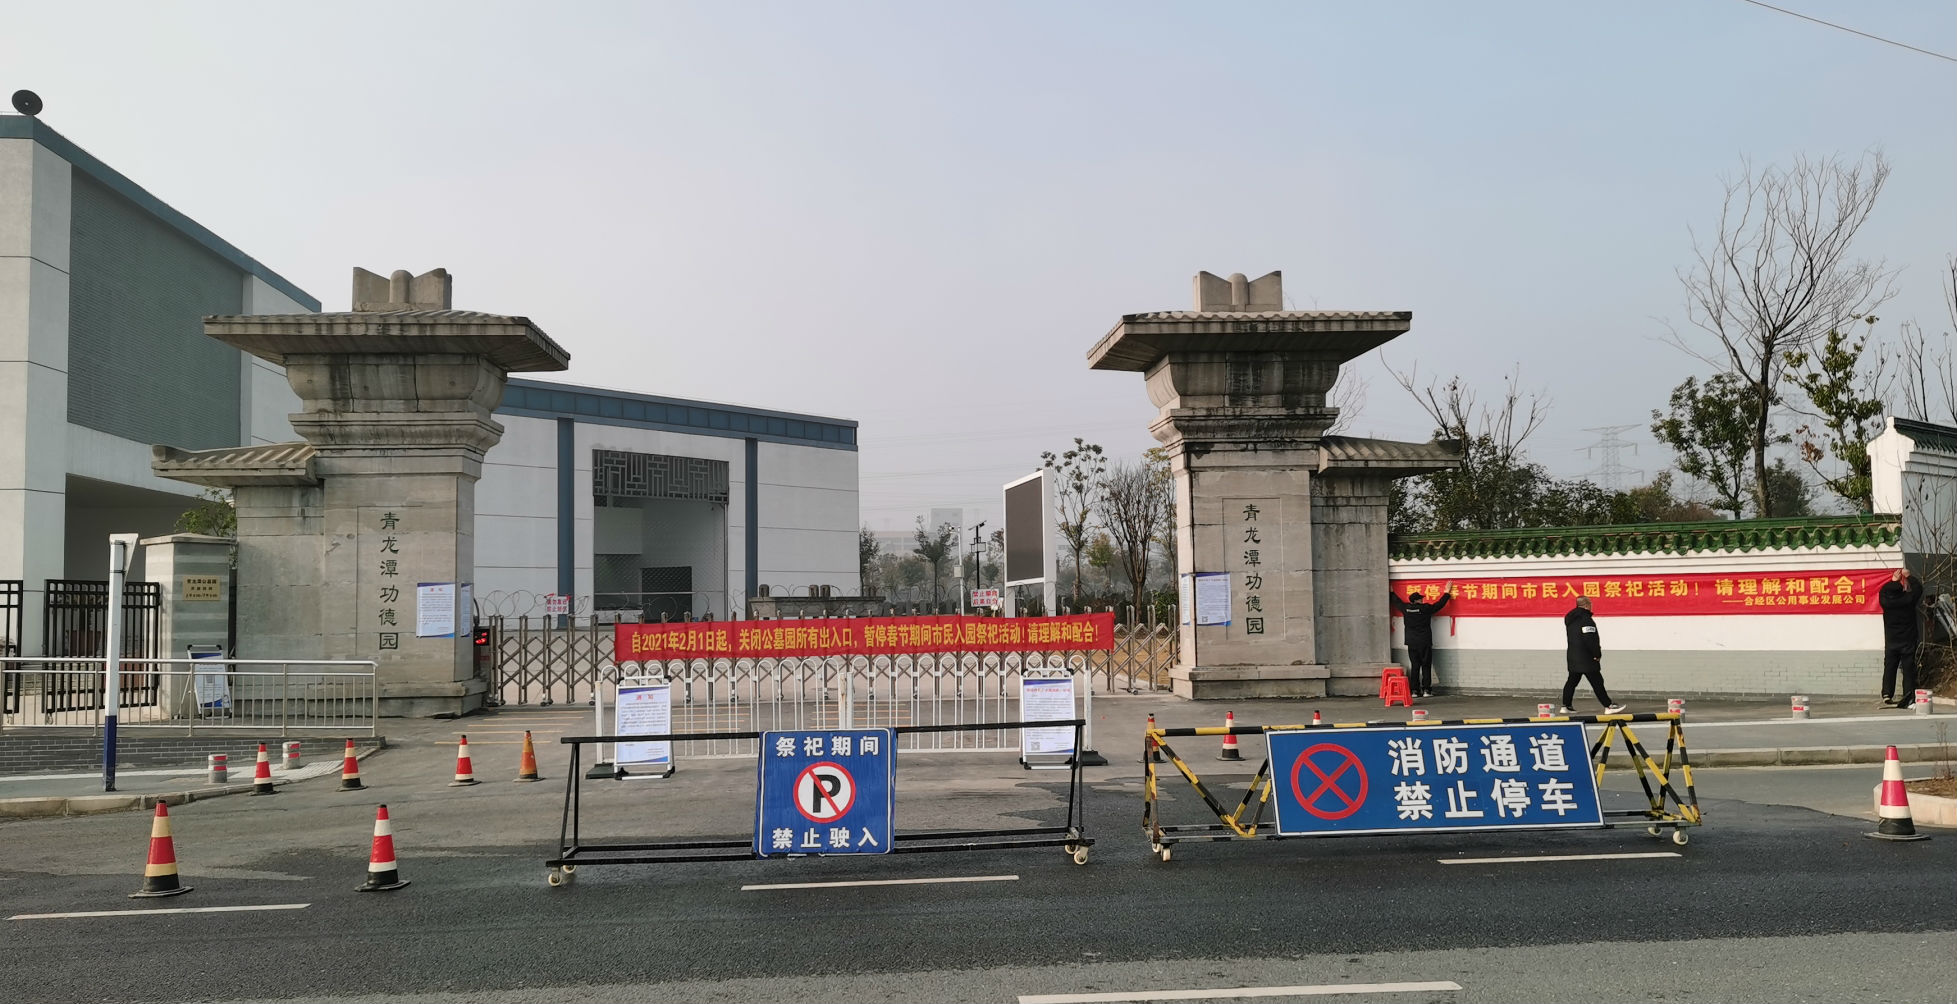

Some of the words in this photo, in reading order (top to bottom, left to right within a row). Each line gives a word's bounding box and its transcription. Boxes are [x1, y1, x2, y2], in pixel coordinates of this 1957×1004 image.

[379, 512, 400, 650] 青龙潭功德园
[1243, 504, 1264, 635] 青龙潭功德园
[776, 736, 879, 757] 祭祀期间
[1387, 733, 1569, 776] 消防通道
[1394, 777, 1578, 821] 禁止停车
[773, 827, 879, 849] 禁止驶入
